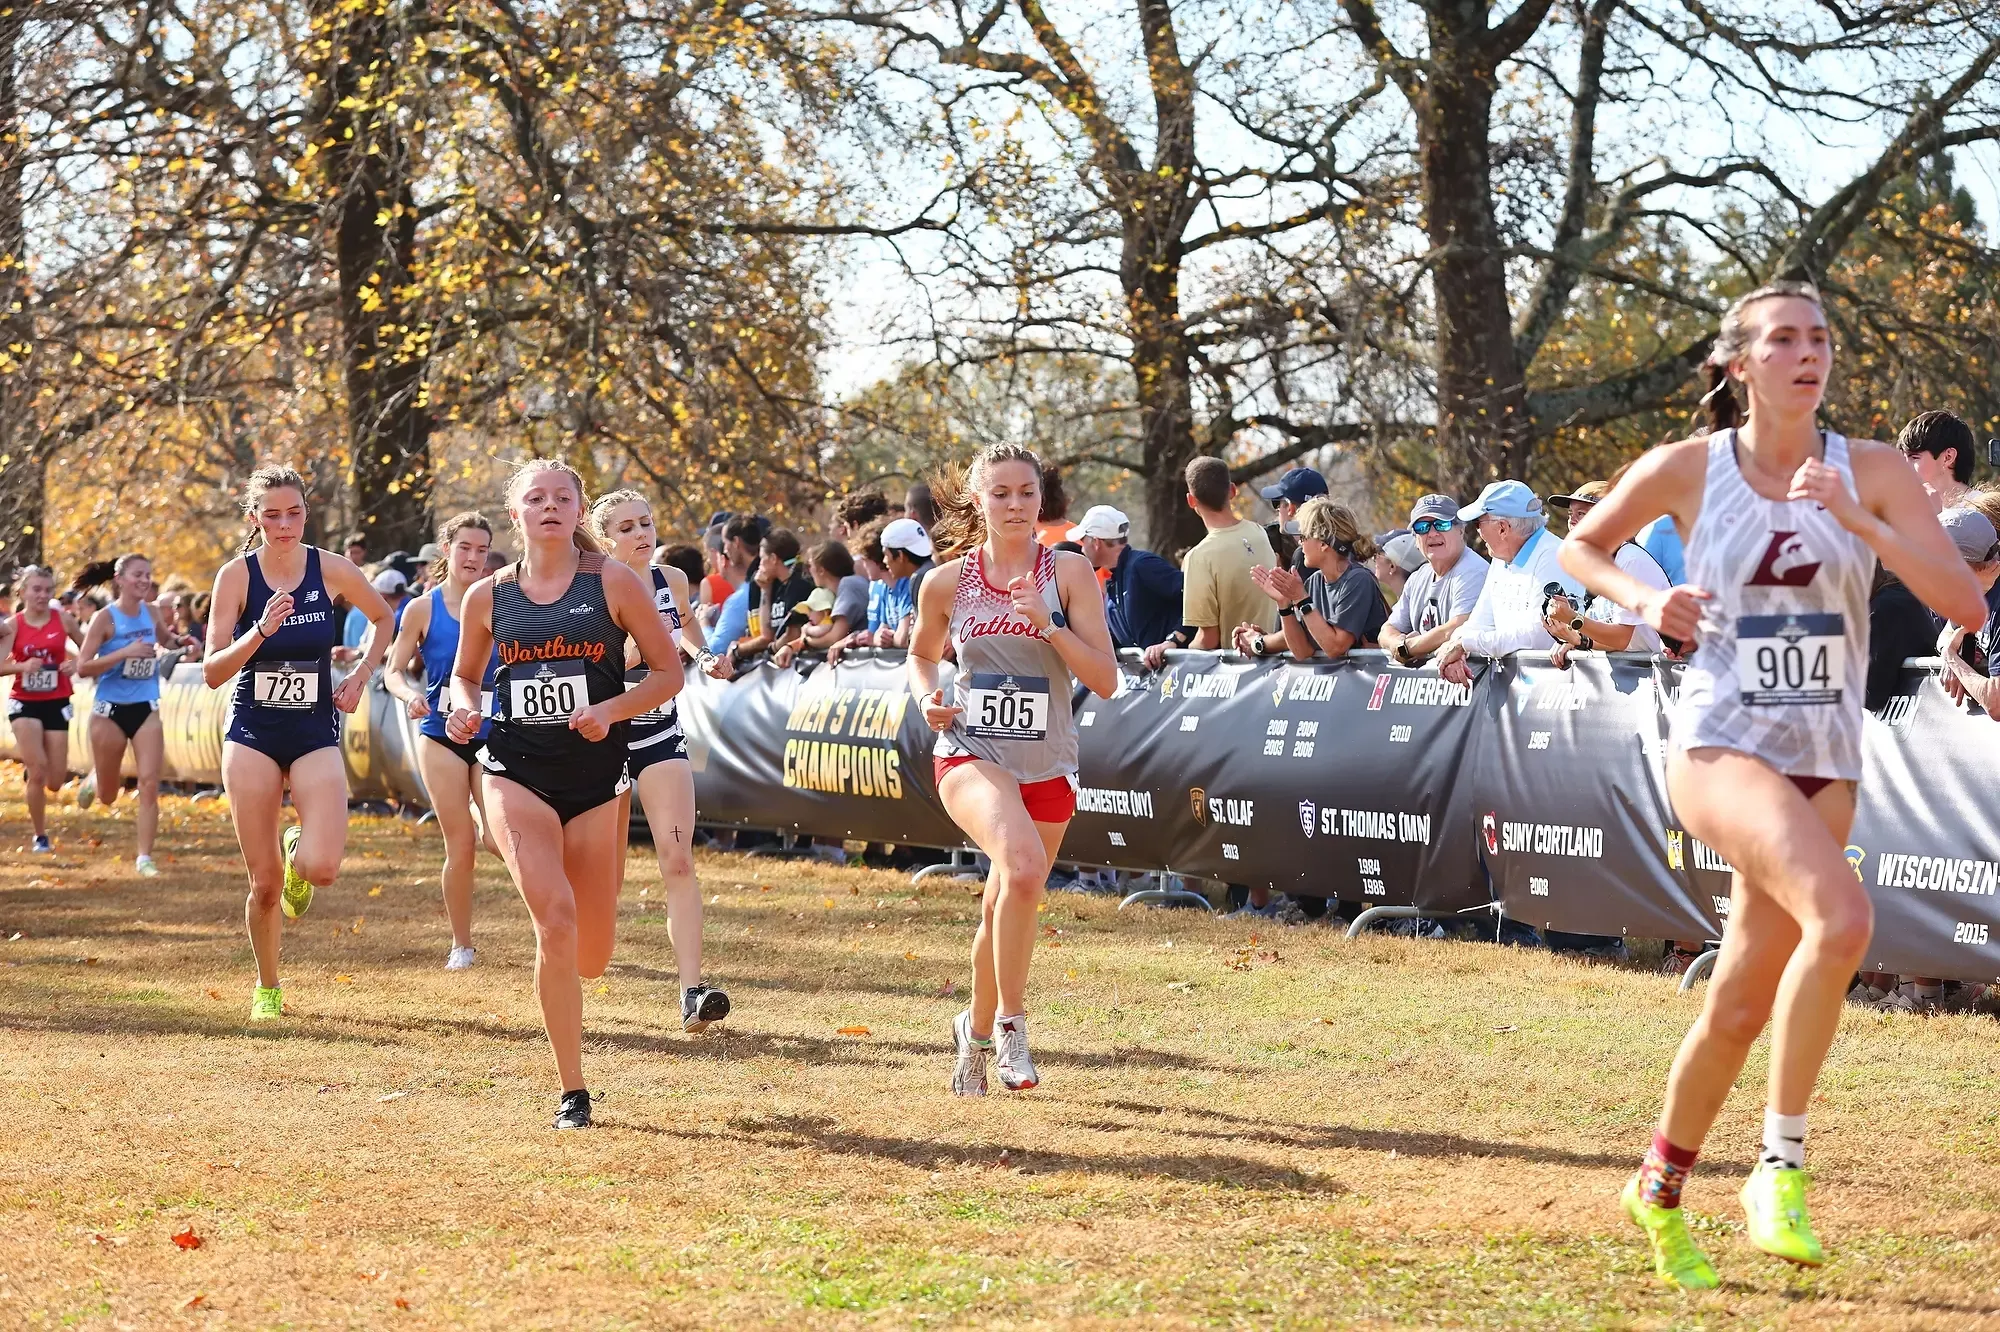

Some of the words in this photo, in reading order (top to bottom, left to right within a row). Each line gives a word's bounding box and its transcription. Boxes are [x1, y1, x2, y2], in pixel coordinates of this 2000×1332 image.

[498, 635, 606, 664] Wartburg
[130, 659, 152, 676] 568
[1756, 644, 1830, 689] 904
[28, 671, 52, 688] 654
[266, 676, 306, 702] 723
[1288, 675, 1338, 702] CALVIN
[523, 682, 576, 717] 860
[981, 695, 1035, 729] 505
[785, 688, 857, 735] MEN'S
[848, 688, 911, 741] TEAM
[1266, 719, 1289, 736] 2000
[1296, 721, 1320, 738] 2004
[1389, 725, 1412, 743] 2010
[1527, 731, 1551, 750] 1985
[1263, 739, 1285, 756] 2003
[1292, 741, 1315, 758] 2006
[783, 738, 903, 799] CHAMPIONS
[1076, 787, 1131, 815] ROCHESTER
[1131, 789, 1154, 819] (NY)
[1209, 797, 1227, 824] ST.
[1228, 799, 1255, 827] OLAF
[1107, 831, 1127, 847] 1991
[1321, 807, 1339, 836] ST.
[1341, 809, 1396, 841] THOMAS
[1398, 811, 1431, 846] (MN)
[1222, 843, 1240, 860] 2013
[1502, 821, 1534, 853] SUNY
[1535, 824, 1603, 858] CORTLAND
[1357, 857, 1381, 876] 1984
[1362, 878, 1386, 896] 1986
[1529, 877, 1549, 897] 2008
[1953, 921, 1989, 946] 2015
